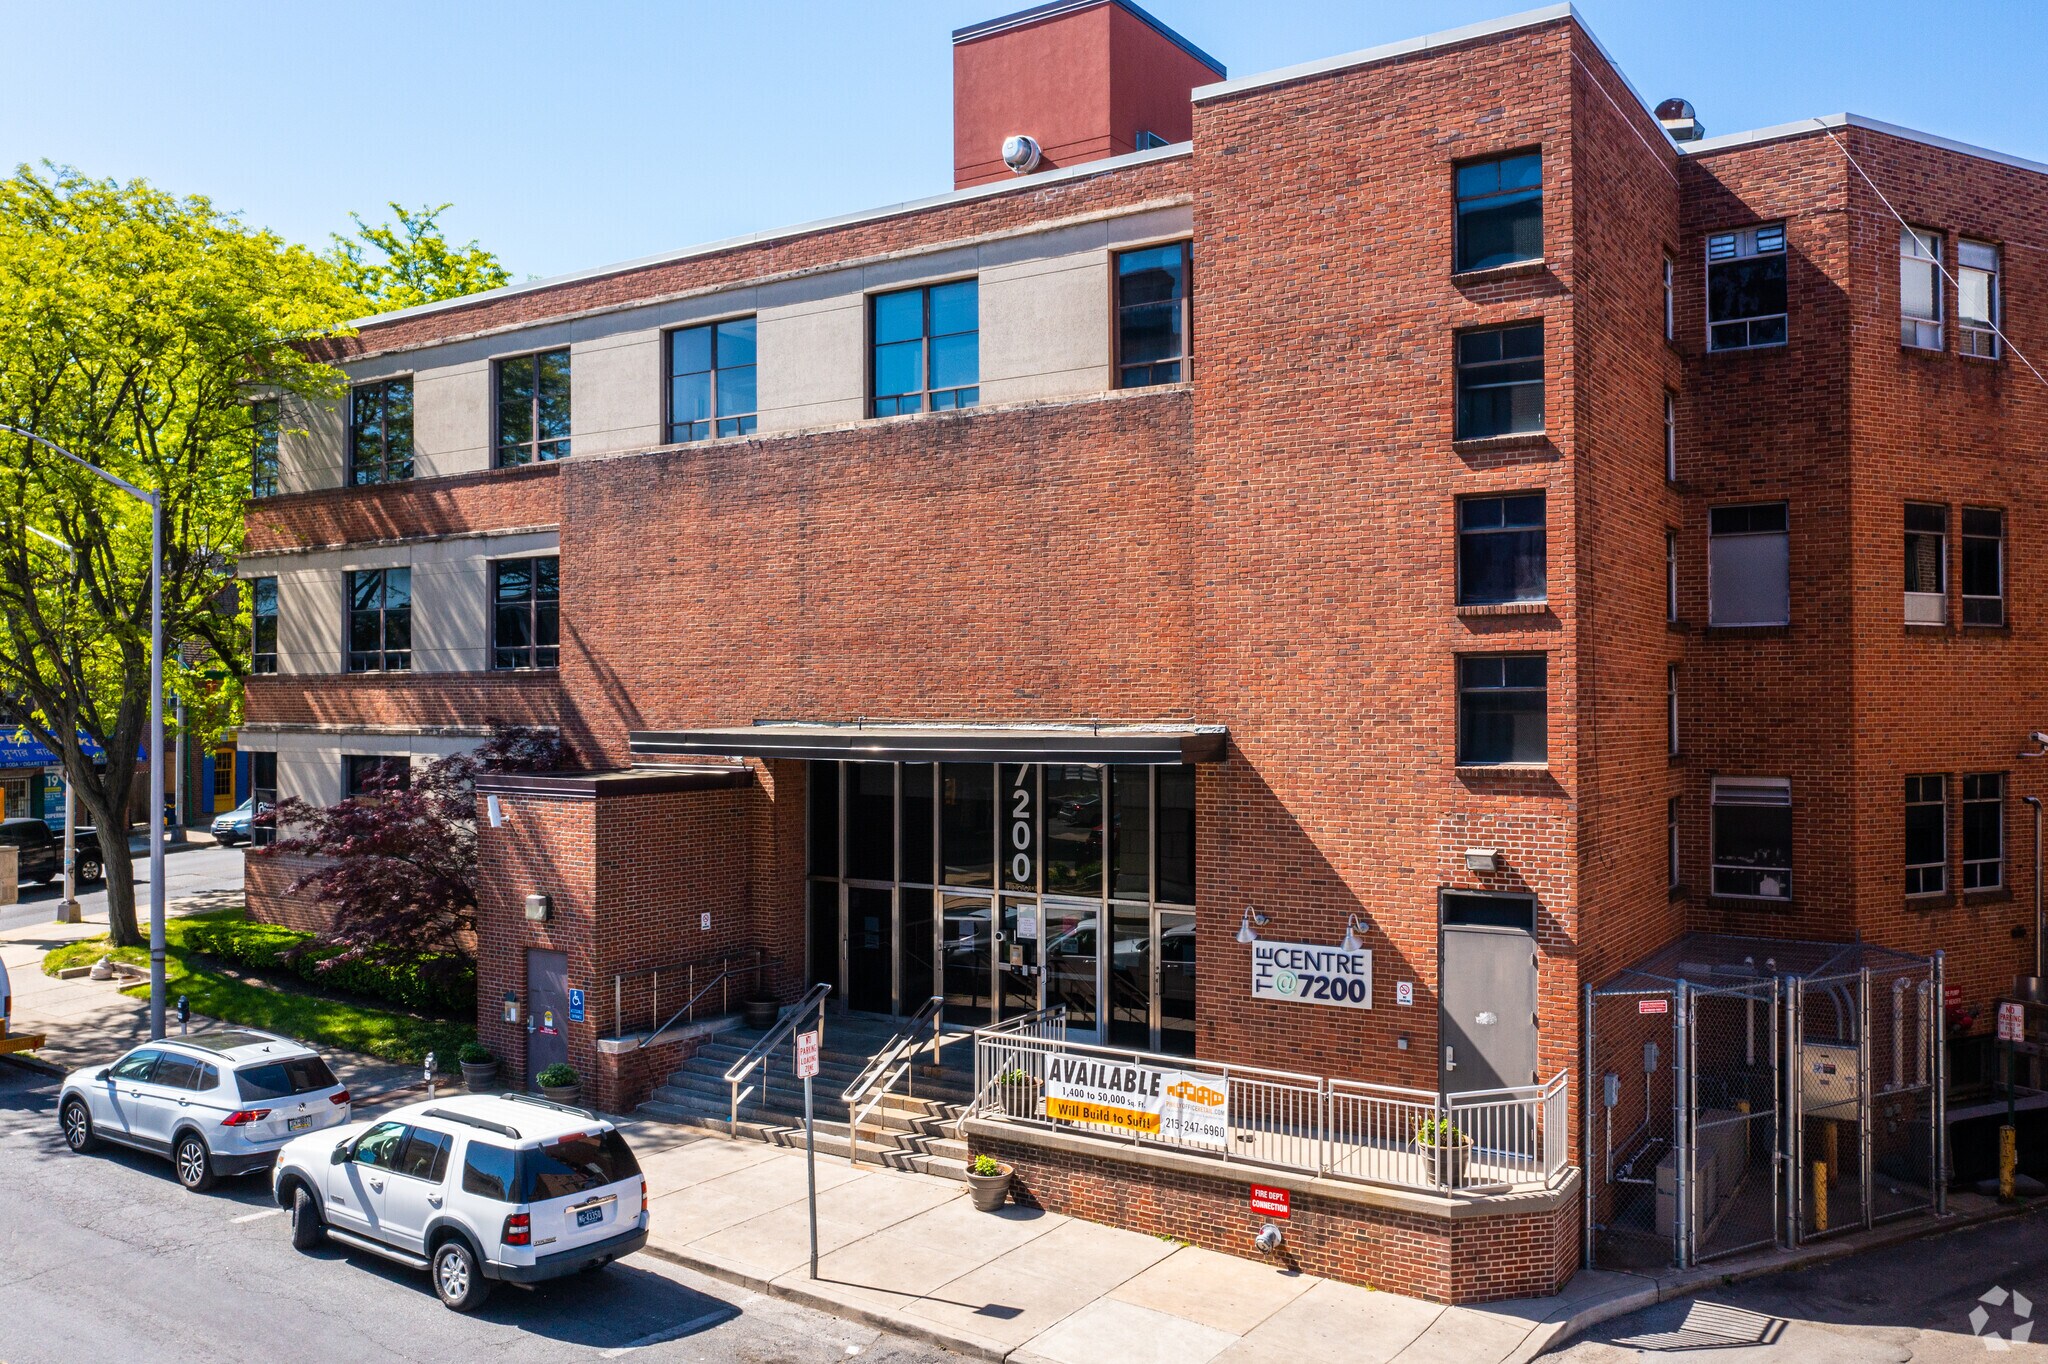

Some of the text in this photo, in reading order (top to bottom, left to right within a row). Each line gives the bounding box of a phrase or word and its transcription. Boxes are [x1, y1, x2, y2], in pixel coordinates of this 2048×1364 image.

[46, 775, 59, 787] 19
[1256, 947, 1273, 992] THE
[1274, 948, 1364, 976] CENTRE
[2005, 1006, 2015, 1014] NO
[800, 1044, 817, 1055] PARKING
[800, 1055, 816, 1065] LOADING
[1049, 1058, 1161, 1097] AVAILABLE
[1062, 1086, 1085, 1098] 1,400
[1087, 1091, 1095, 1100] to
[1098, 1092, 1126, 1105] 50,000
[1058, 1103, 1079, 1117] Will
[1083, 1107, 1110, 1122] Build
[1113, 1113, 1124, 1124] to
[1127, 1114, 1151, 1129] Suit!
[1166, 1117, 1225, 1138] 215-247-6960
[1255, 1189, 1285, 1201] FIRE DEPT.
[1252, 1199, 1288, 1213] CONNECTION
